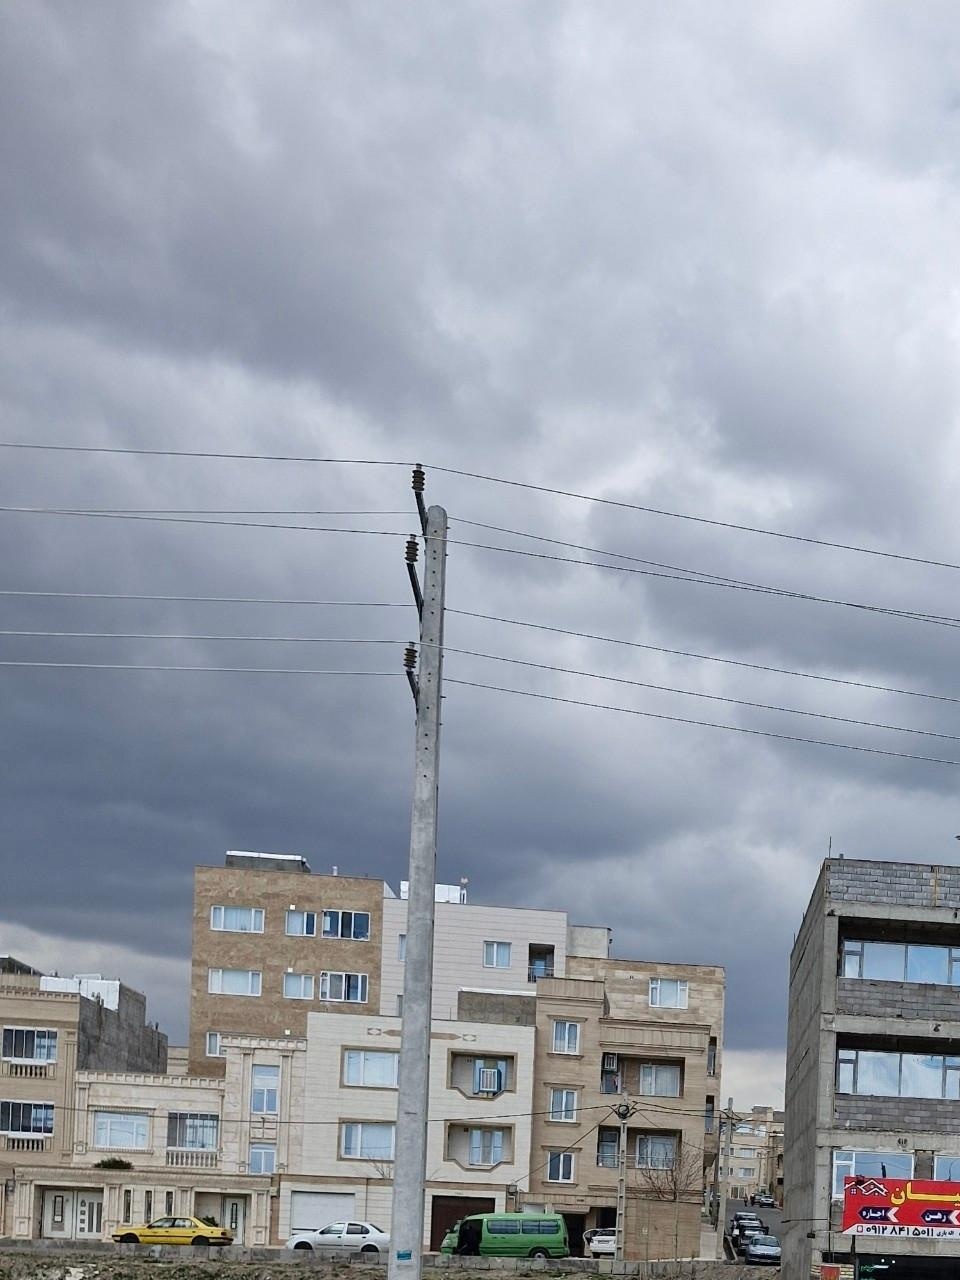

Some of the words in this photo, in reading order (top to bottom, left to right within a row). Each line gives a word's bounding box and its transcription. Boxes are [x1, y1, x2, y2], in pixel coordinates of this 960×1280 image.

[861, 1208, 885, 1221] اجاره
[924, 1211, 947, 1223] رهن
[866, 1225, 888, 1235] ۰۹۱۲
[890, 1226, 910, 1236] ۸۴۱
[912, 1228, 934, 1237] ۵۰۱۱
